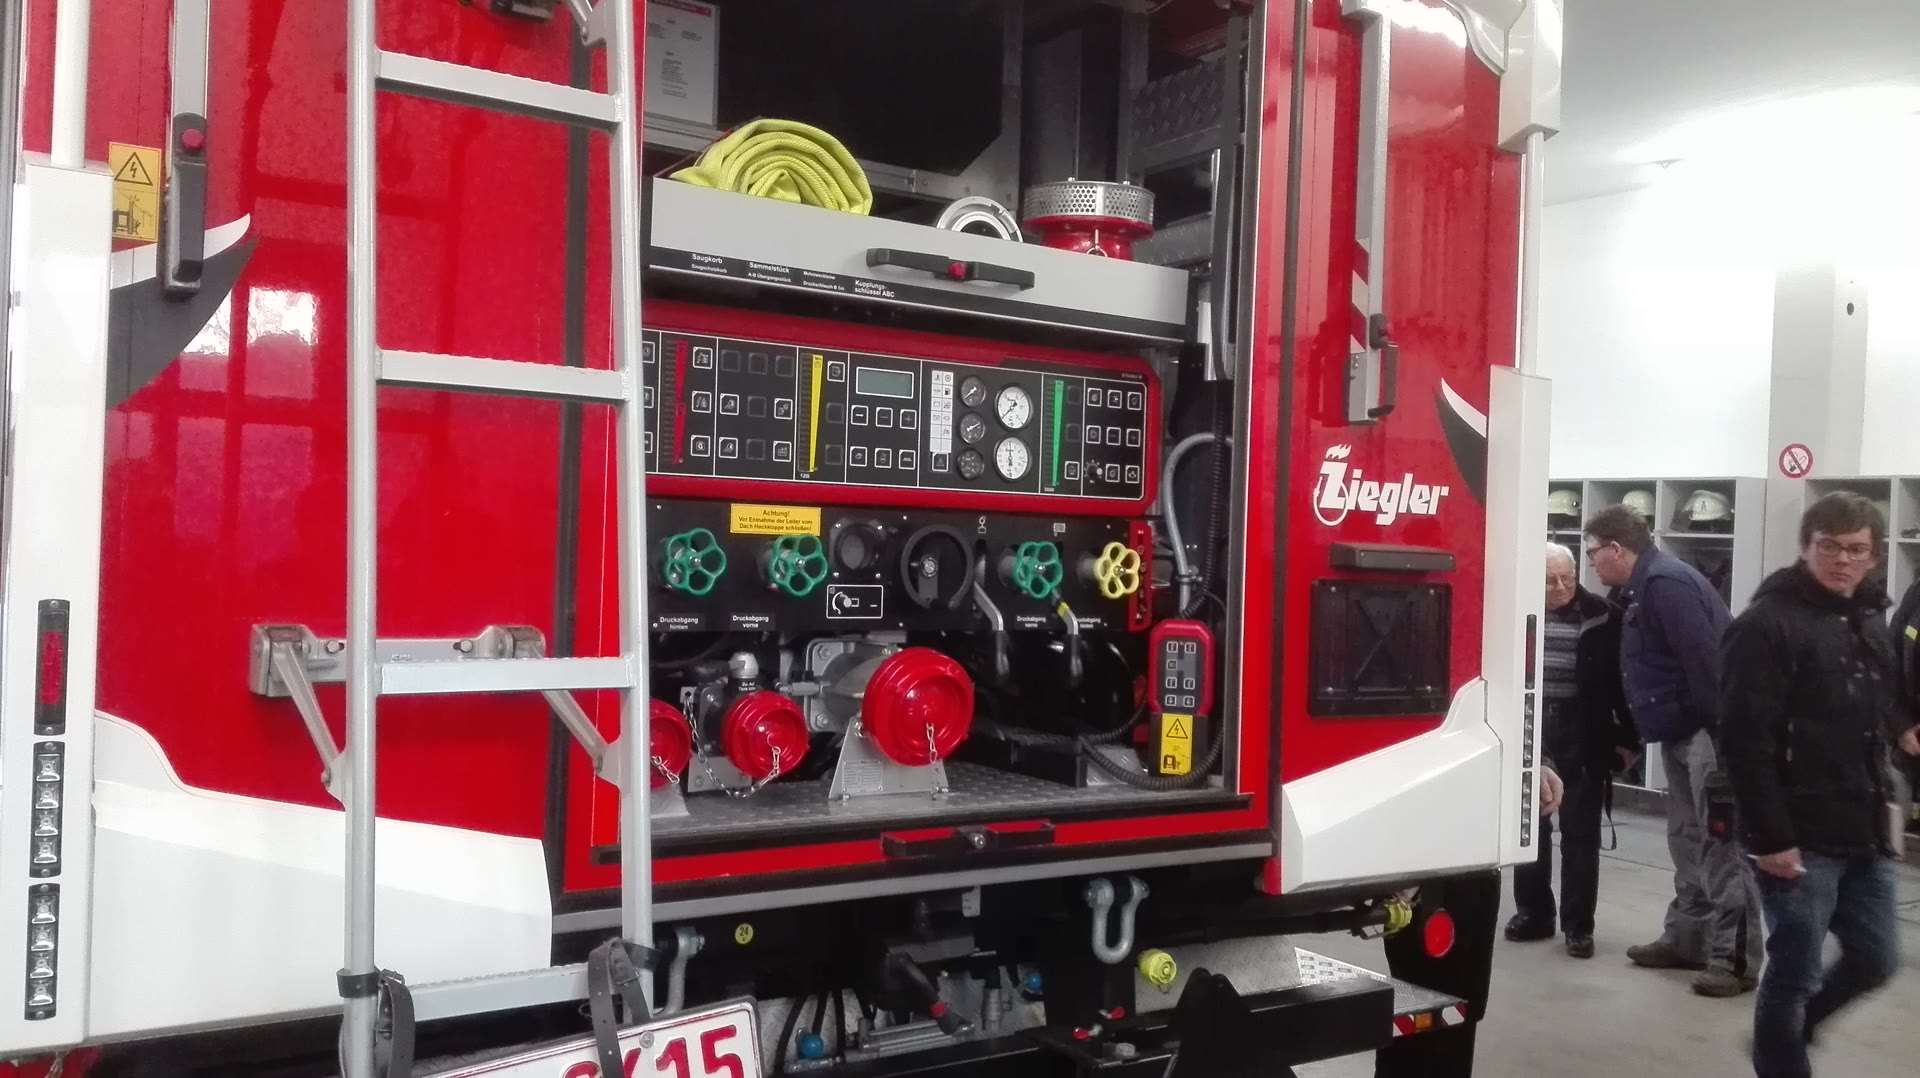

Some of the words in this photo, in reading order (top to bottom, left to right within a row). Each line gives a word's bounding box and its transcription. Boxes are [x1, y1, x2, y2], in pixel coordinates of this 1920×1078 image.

[691, 253, 723, 264] Saugkorb
[749, 261, 790, 274] Sammelstück
[855, 279, 888, 290] Kupplungs-
[854, 287, 882, 297] schlüssel
[881, 290, 895, 298] ABC
[1313, 460, 1450, 526] Ziegler
[762, 509, 790, 518] Achtung!
[660, 616, 699, 625] Druckabgang
[732, 615, 769, 623] Druckabgang
[739, 926, 750, 937] 24
